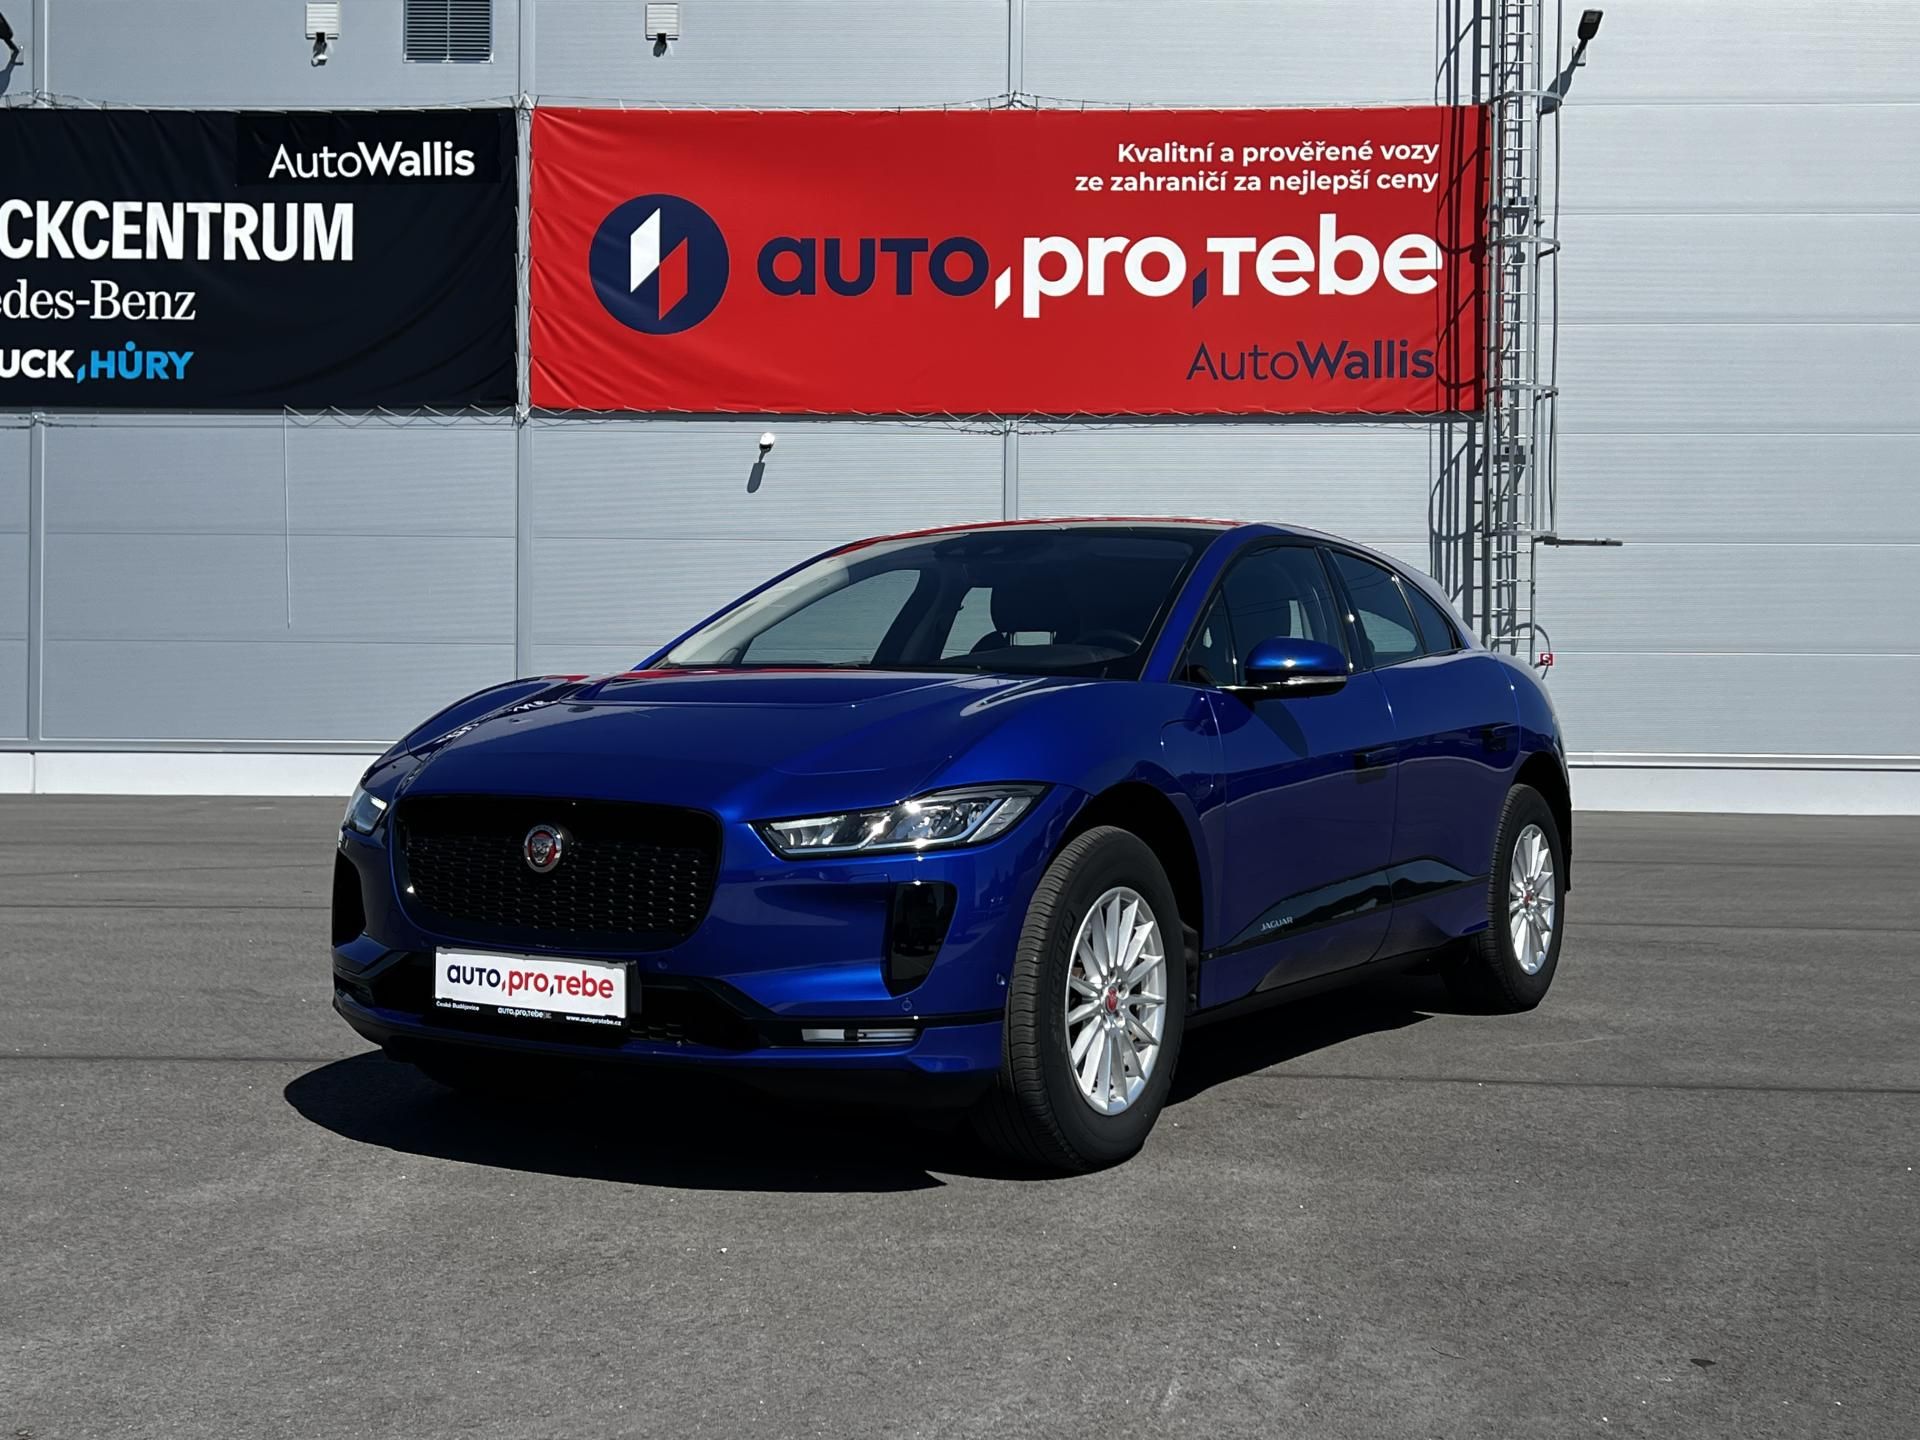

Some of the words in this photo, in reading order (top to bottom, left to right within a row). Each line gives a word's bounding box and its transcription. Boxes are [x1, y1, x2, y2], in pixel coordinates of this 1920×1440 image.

[269, 140, 475, 179] AutoWallis
[1118, 141, 1215, 163] Kvalitní
[1221, 147, 1234, 163] a
[1243, 141, 1374, 167] prověřené
[1381, 143, 1440, 165] vozy
[1075, 176, 1104, 192] ze
[1111, 169, 1228, 192] zahraničí
[1234, 174, 1261, 191] za
[1269, 168, 1370, 195] nejlepší
[1377, 172, 1439, 193] ceny
[0, 198, 354, 262] CKCENTRUM
[0, 278, 196, 321] des-Benz
[1187, 340, 1435, 381] AutoWallis
[1260, 916, 1293, 931] JAGUAR
